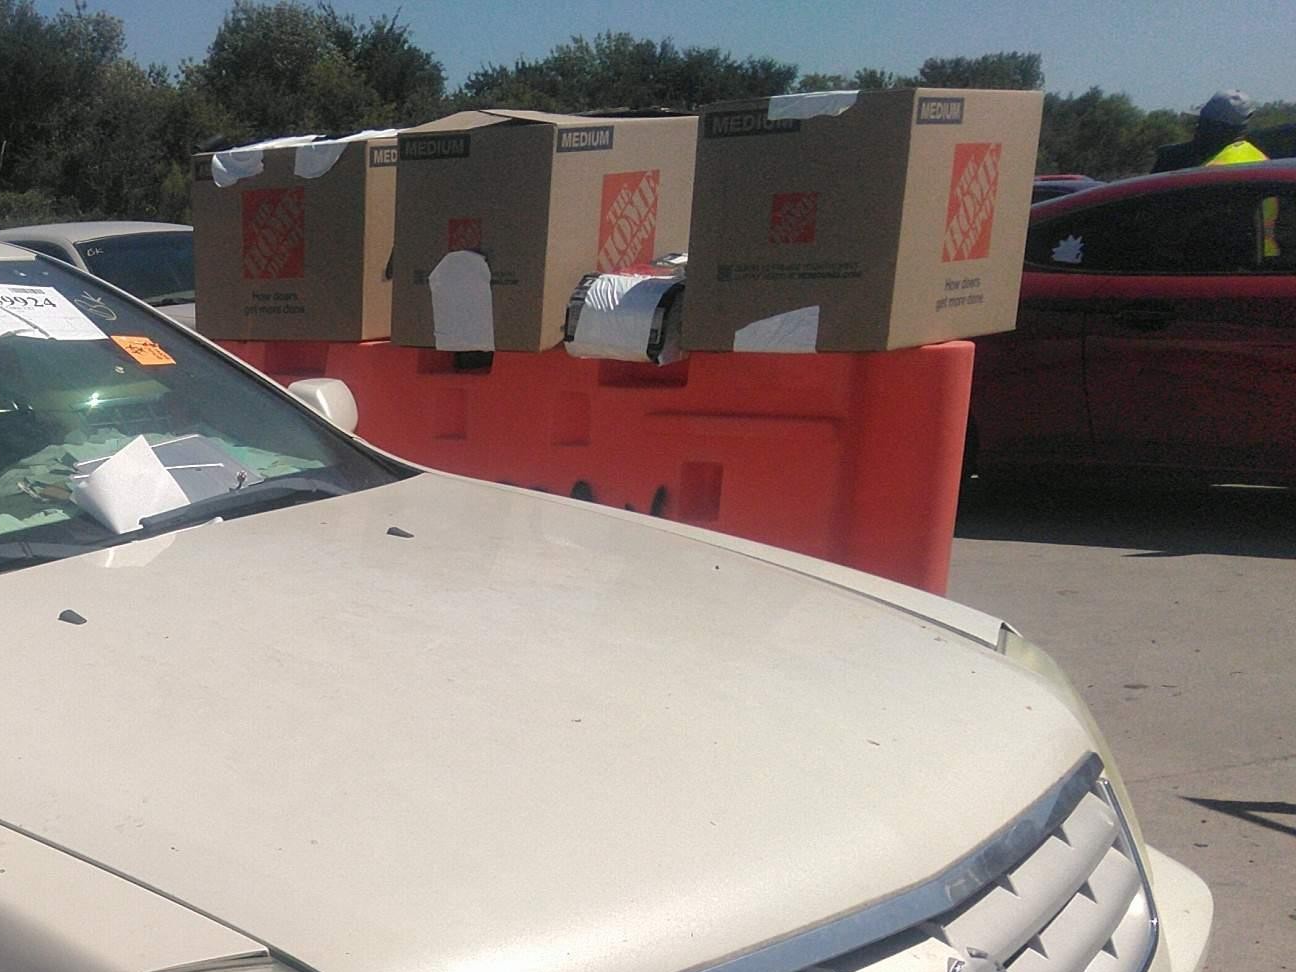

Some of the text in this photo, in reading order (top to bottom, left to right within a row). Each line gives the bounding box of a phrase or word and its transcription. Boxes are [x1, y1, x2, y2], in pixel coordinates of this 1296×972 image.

[920, 101, 962, 120] MEDIUM
[406, 139, 465, 156] MEDIUM
[561, 130, 610, 148] MEDIUM
[373, 148, 398, 163] MED
[597, 170, 660, 273] HOME
